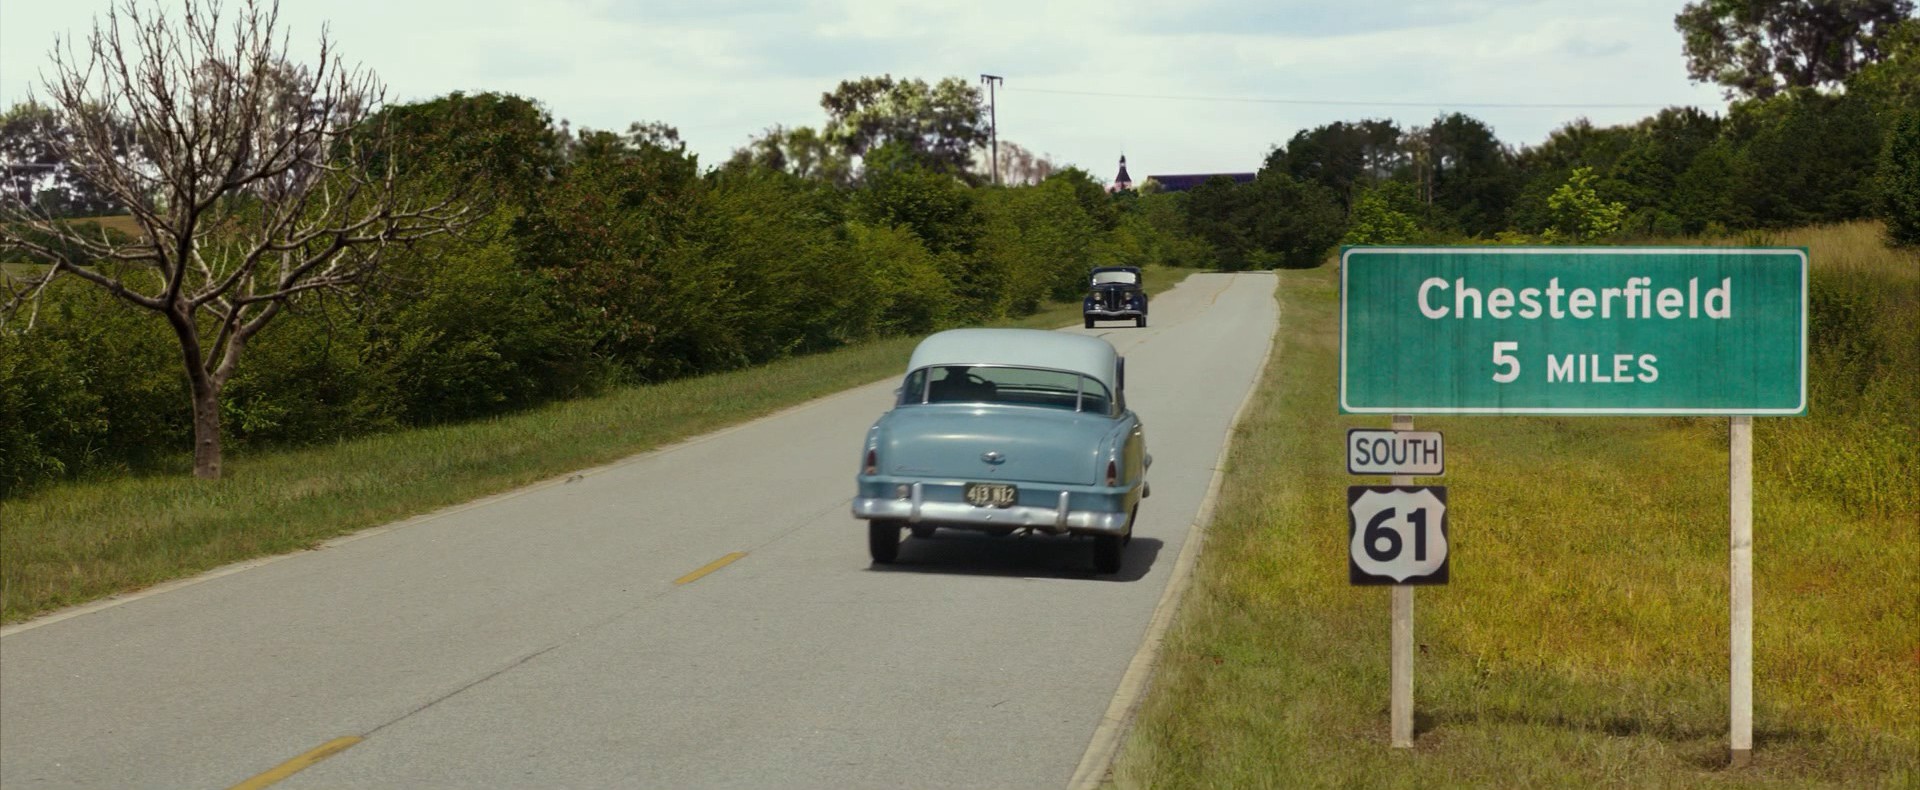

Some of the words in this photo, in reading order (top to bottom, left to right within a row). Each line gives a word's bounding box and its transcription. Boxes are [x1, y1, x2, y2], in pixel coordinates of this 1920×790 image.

[1417, 276, 1732, 319] Chesterfield
[1491, 341, 1521, 383] 5
[1547, 353, 1659, 383] MILES
[1355, 438, 1438, 465] SOUTH
[1363, 507, 1427, 562] 61
